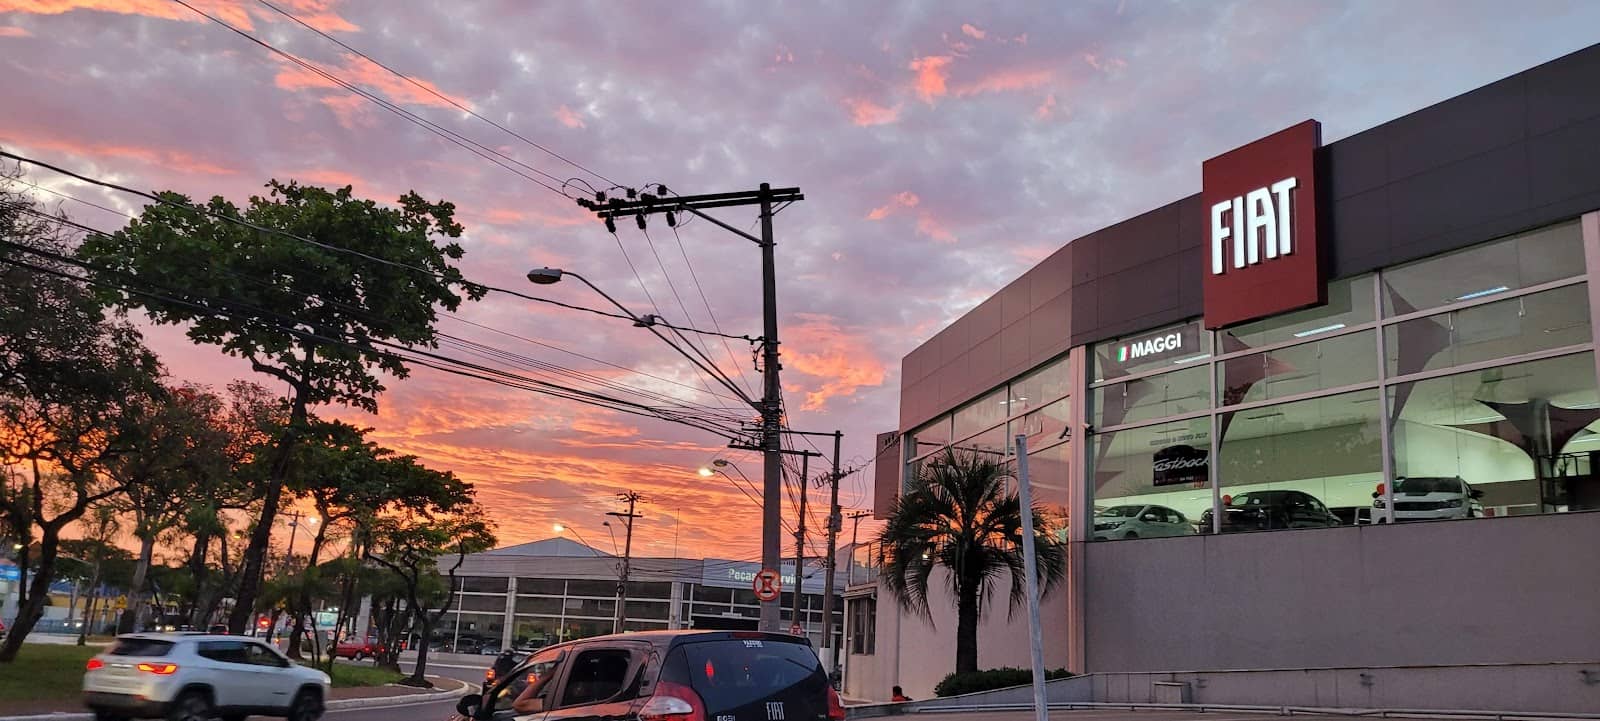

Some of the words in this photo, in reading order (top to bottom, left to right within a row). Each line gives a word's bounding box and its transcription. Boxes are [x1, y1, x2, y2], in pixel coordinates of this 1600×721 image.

[1211, 177, 1296, 275] FIAT
[1131, 332, 1182, 359] MAGGI
[766, 701, 785, 721] FIAT
